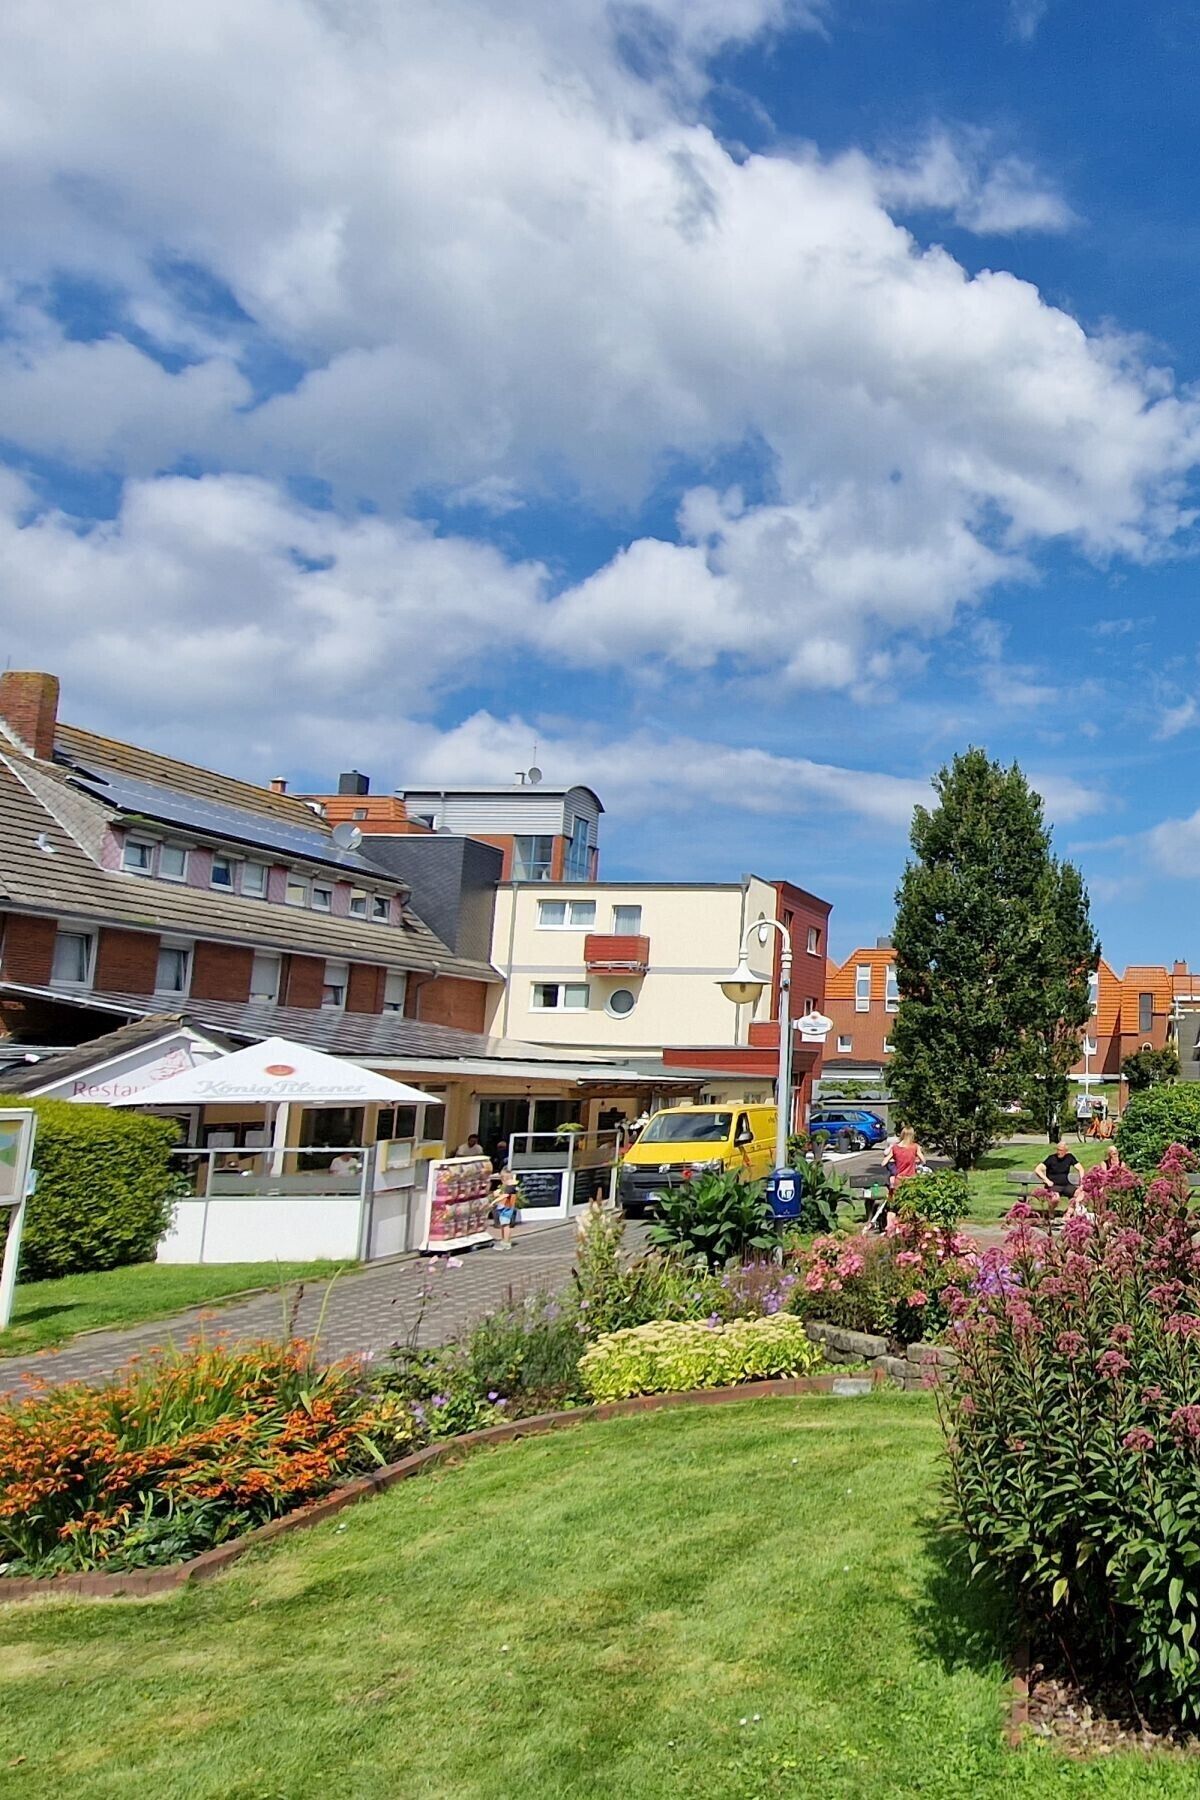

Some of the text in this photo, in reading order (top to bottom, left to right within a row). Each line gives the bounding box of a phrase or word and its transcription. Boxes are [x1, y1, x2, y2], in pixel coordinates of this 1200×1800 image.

[73, 1081, 150, 1097] Restau
[192, 1080, 367, 1096] König Pilsener
